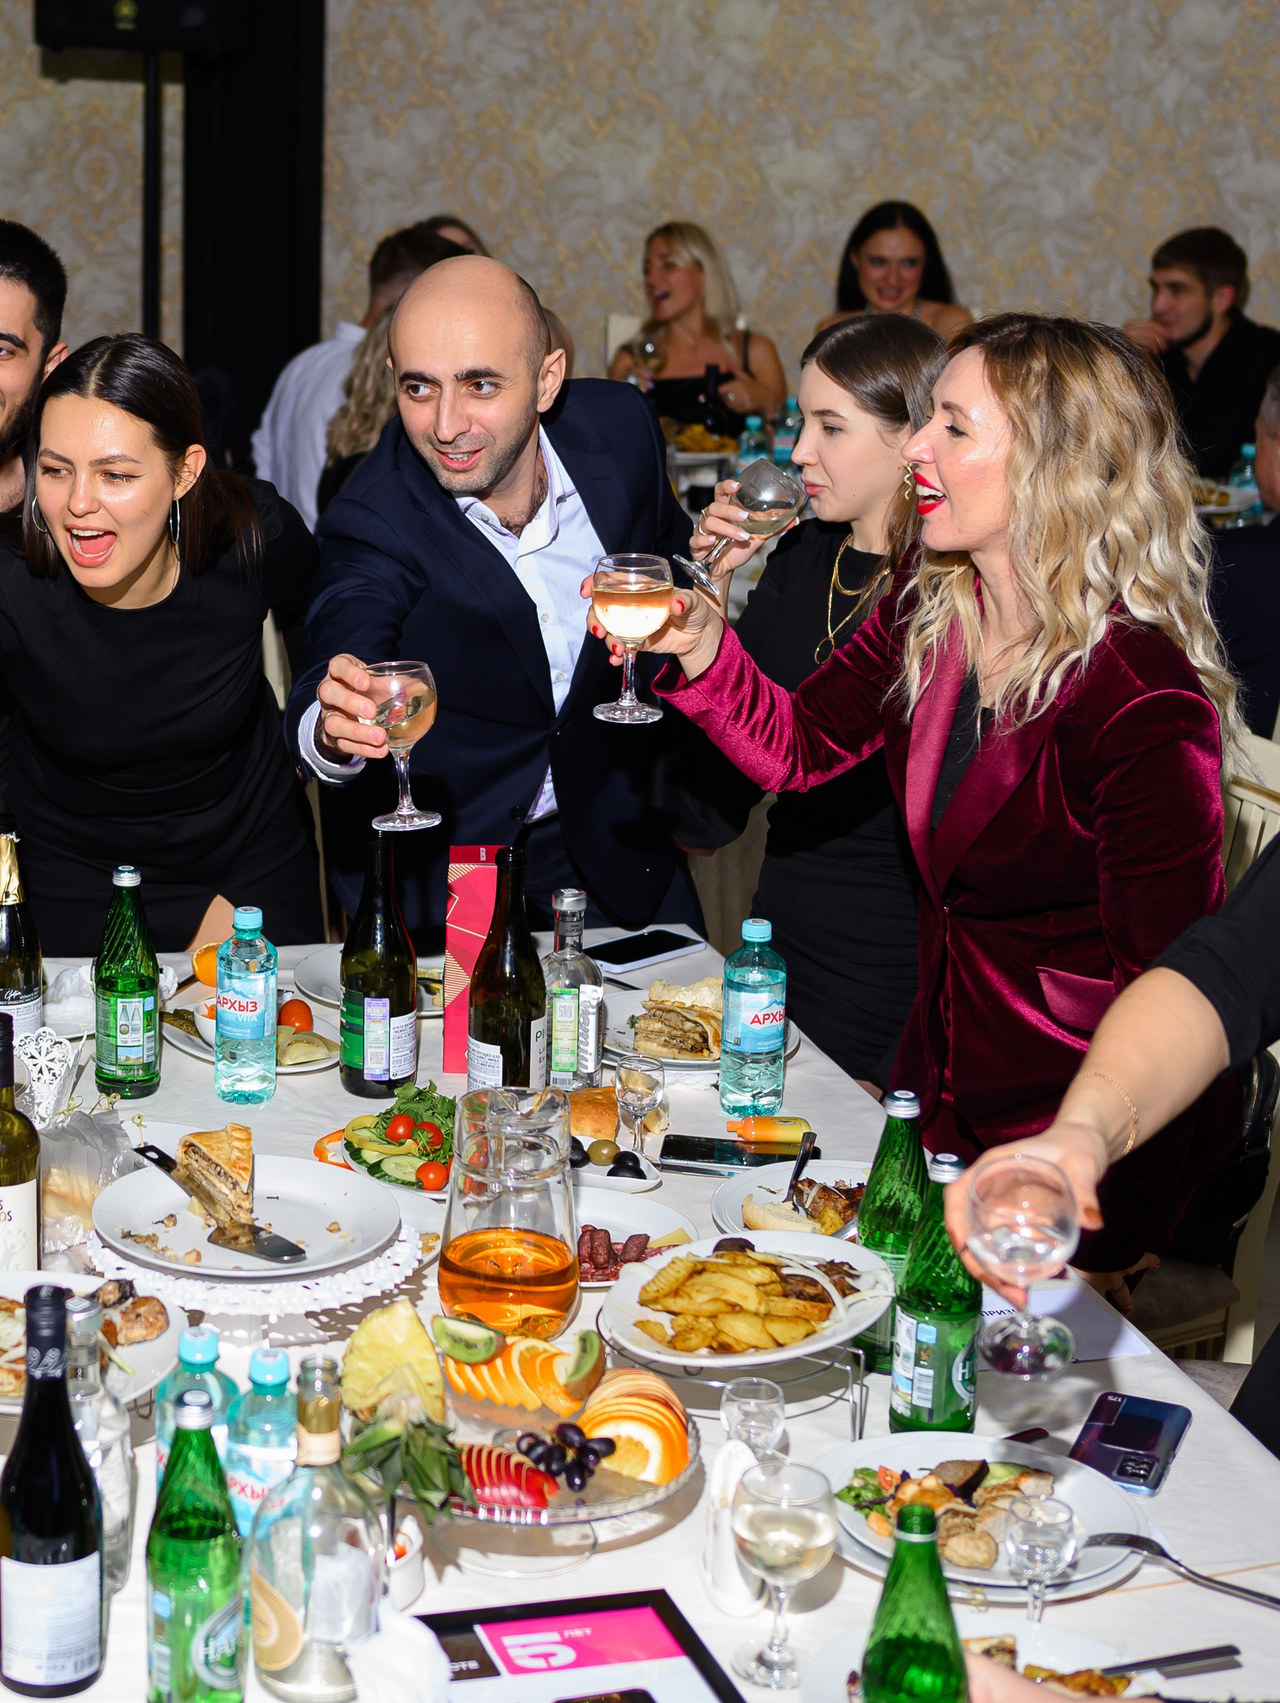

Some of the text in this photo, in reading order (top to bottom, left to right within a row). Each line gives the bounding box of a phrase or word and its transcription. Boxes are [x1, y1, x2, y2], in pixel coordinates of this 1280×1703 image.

[217, 995, 258, 1012] АРХЫЗ
[237, 1014, 258, 1022] VITA
[750, 1006, 786, 1025] АРХЫ
[501, 1631, 577, 1669] 5
